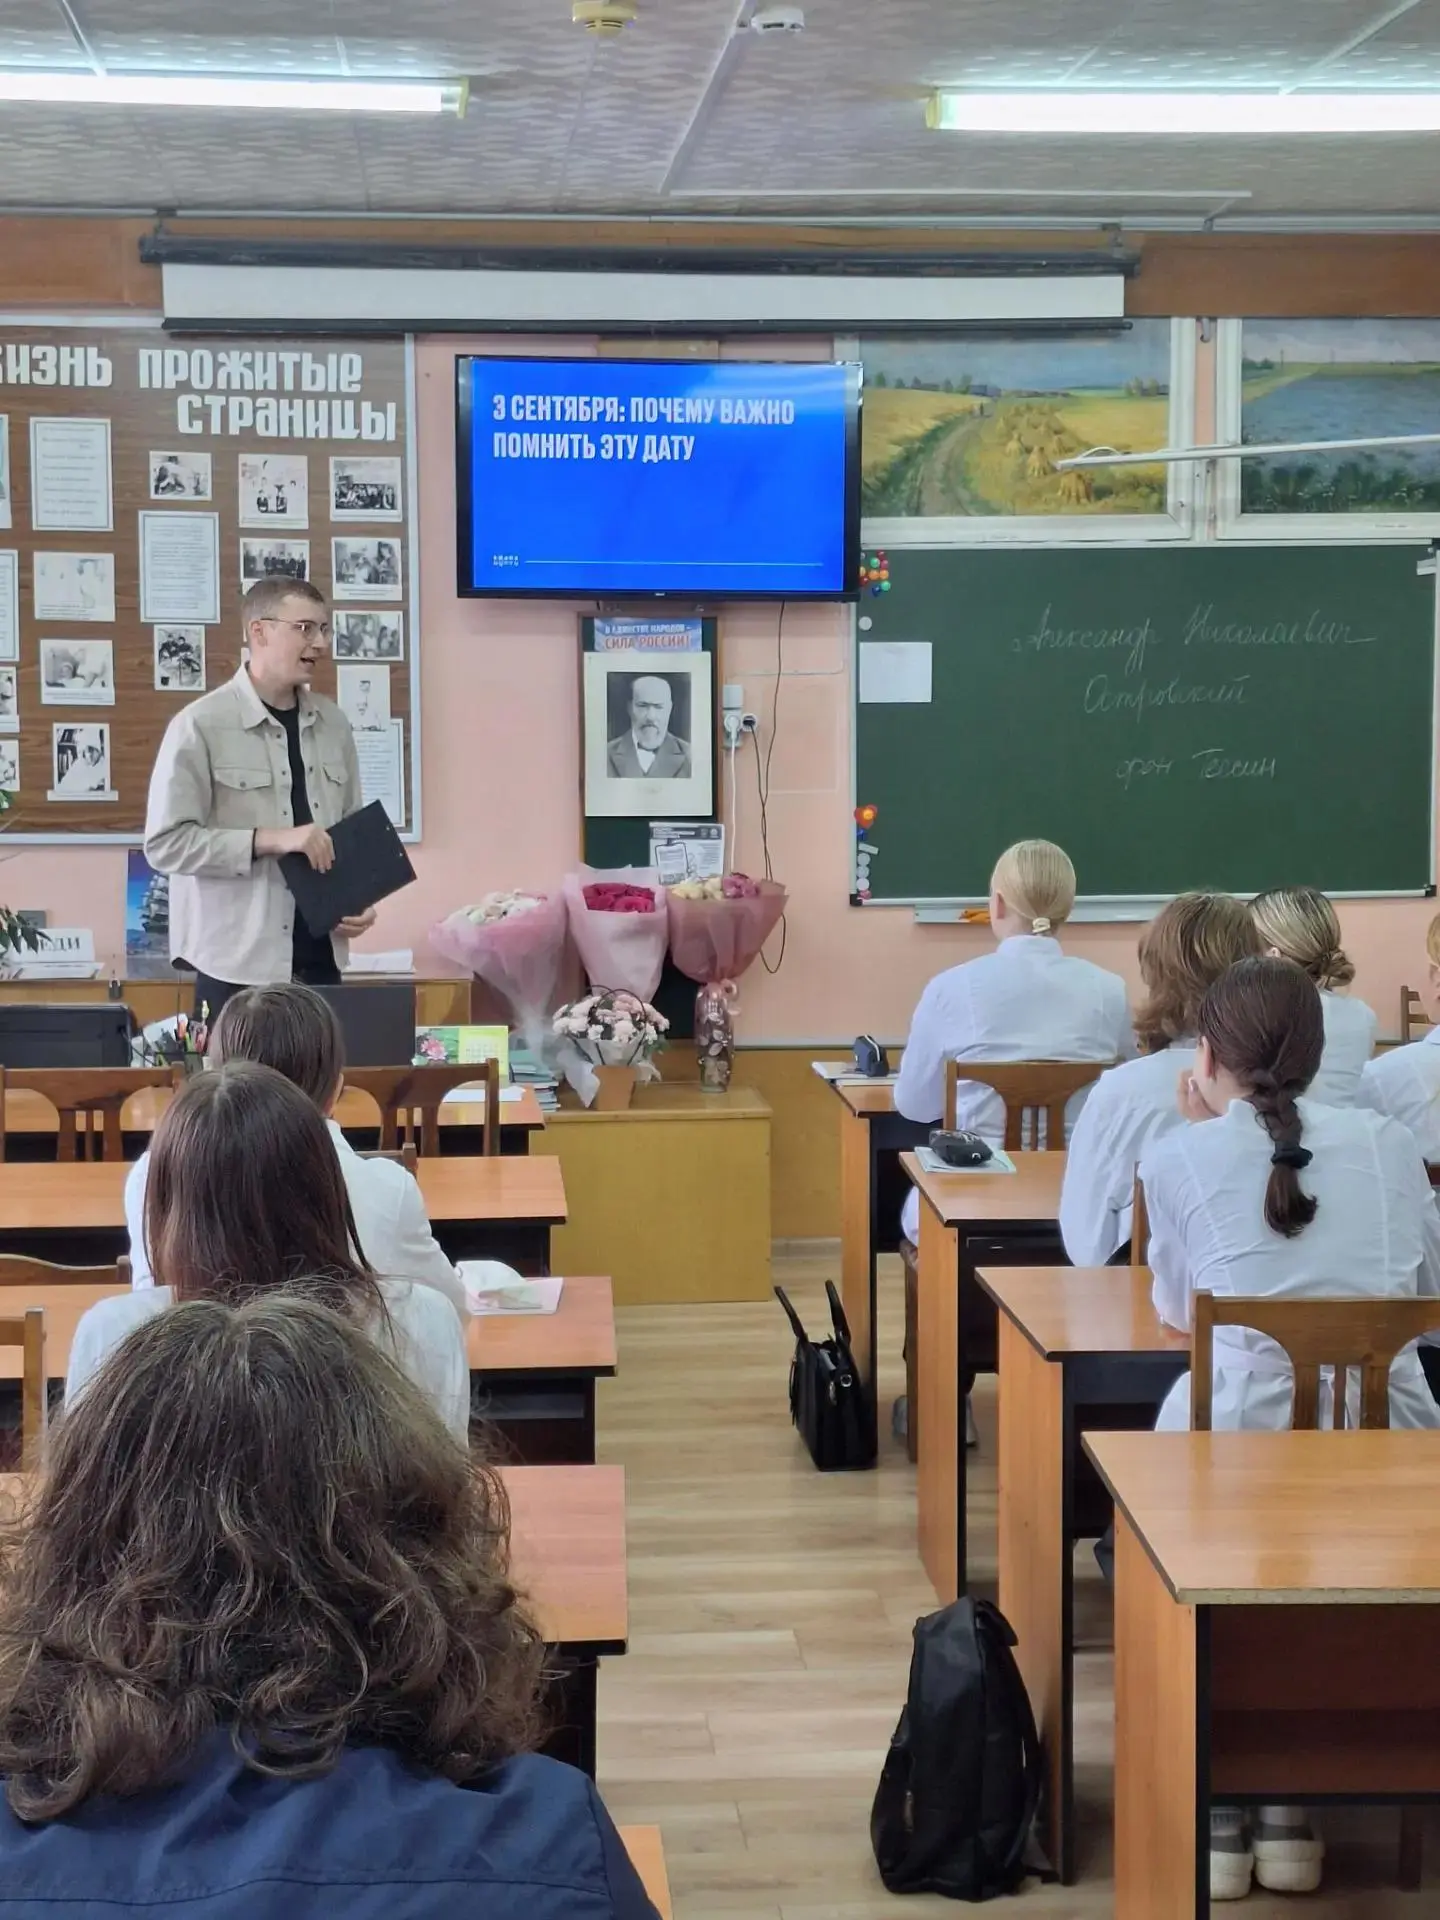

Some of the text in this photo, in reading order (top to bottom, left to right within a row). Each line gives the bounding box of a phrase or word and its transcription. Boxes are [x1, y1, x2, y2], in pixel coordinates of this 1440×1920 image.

[0, 344, 113, 387] ИЗНЬ
[511, 395, 626, 423] СЕНТЯБРЯ:
[630, 396, 716, 425] ПОЧЕМУ
[720, 398, 795, 426] ВАЖНО
[493, 432, 695, 463] ПОМНИТЬ ЭТУ ДАТУ
[605, 635, 691, 650] СИЛА РОССИИ!
